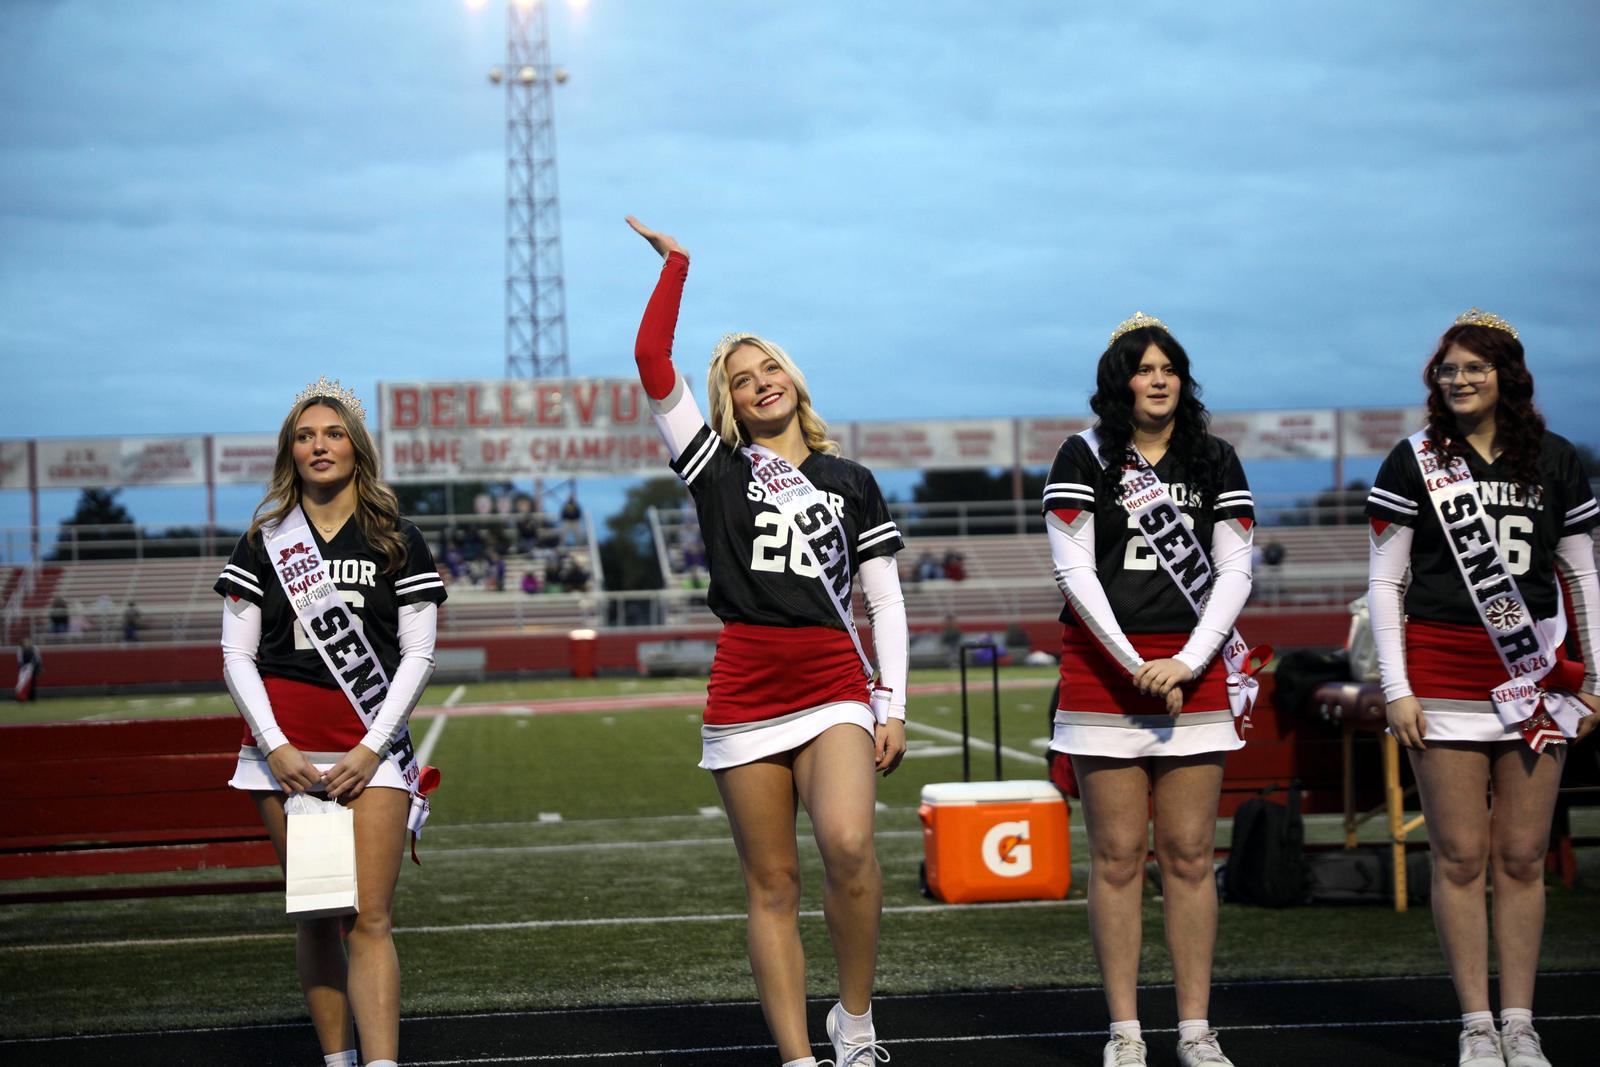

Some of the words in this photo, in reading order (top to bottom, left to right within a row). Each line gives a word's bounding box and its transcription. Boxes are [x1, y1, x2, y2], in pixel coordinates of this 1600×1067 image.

[391, 385, 655, 428] BELLEVU
[394, 437, 460, 464] HOME
[481, 437, 510, 463] OF
[529, 434, 673, 462] CHAMPION
[756, 457, 794, 485] BHS
[1427, 470, 1471, 492] Lexus
[766, 476, 804, 496] Alexa
[1126, 486, 1165, 512] Mercedes
[280, 554, 321, 585] BHS
[287, 570, 325, 597] Kyler
[1510, 655, 1548, 679] 2026
[982, 820, 1032, 877] G
